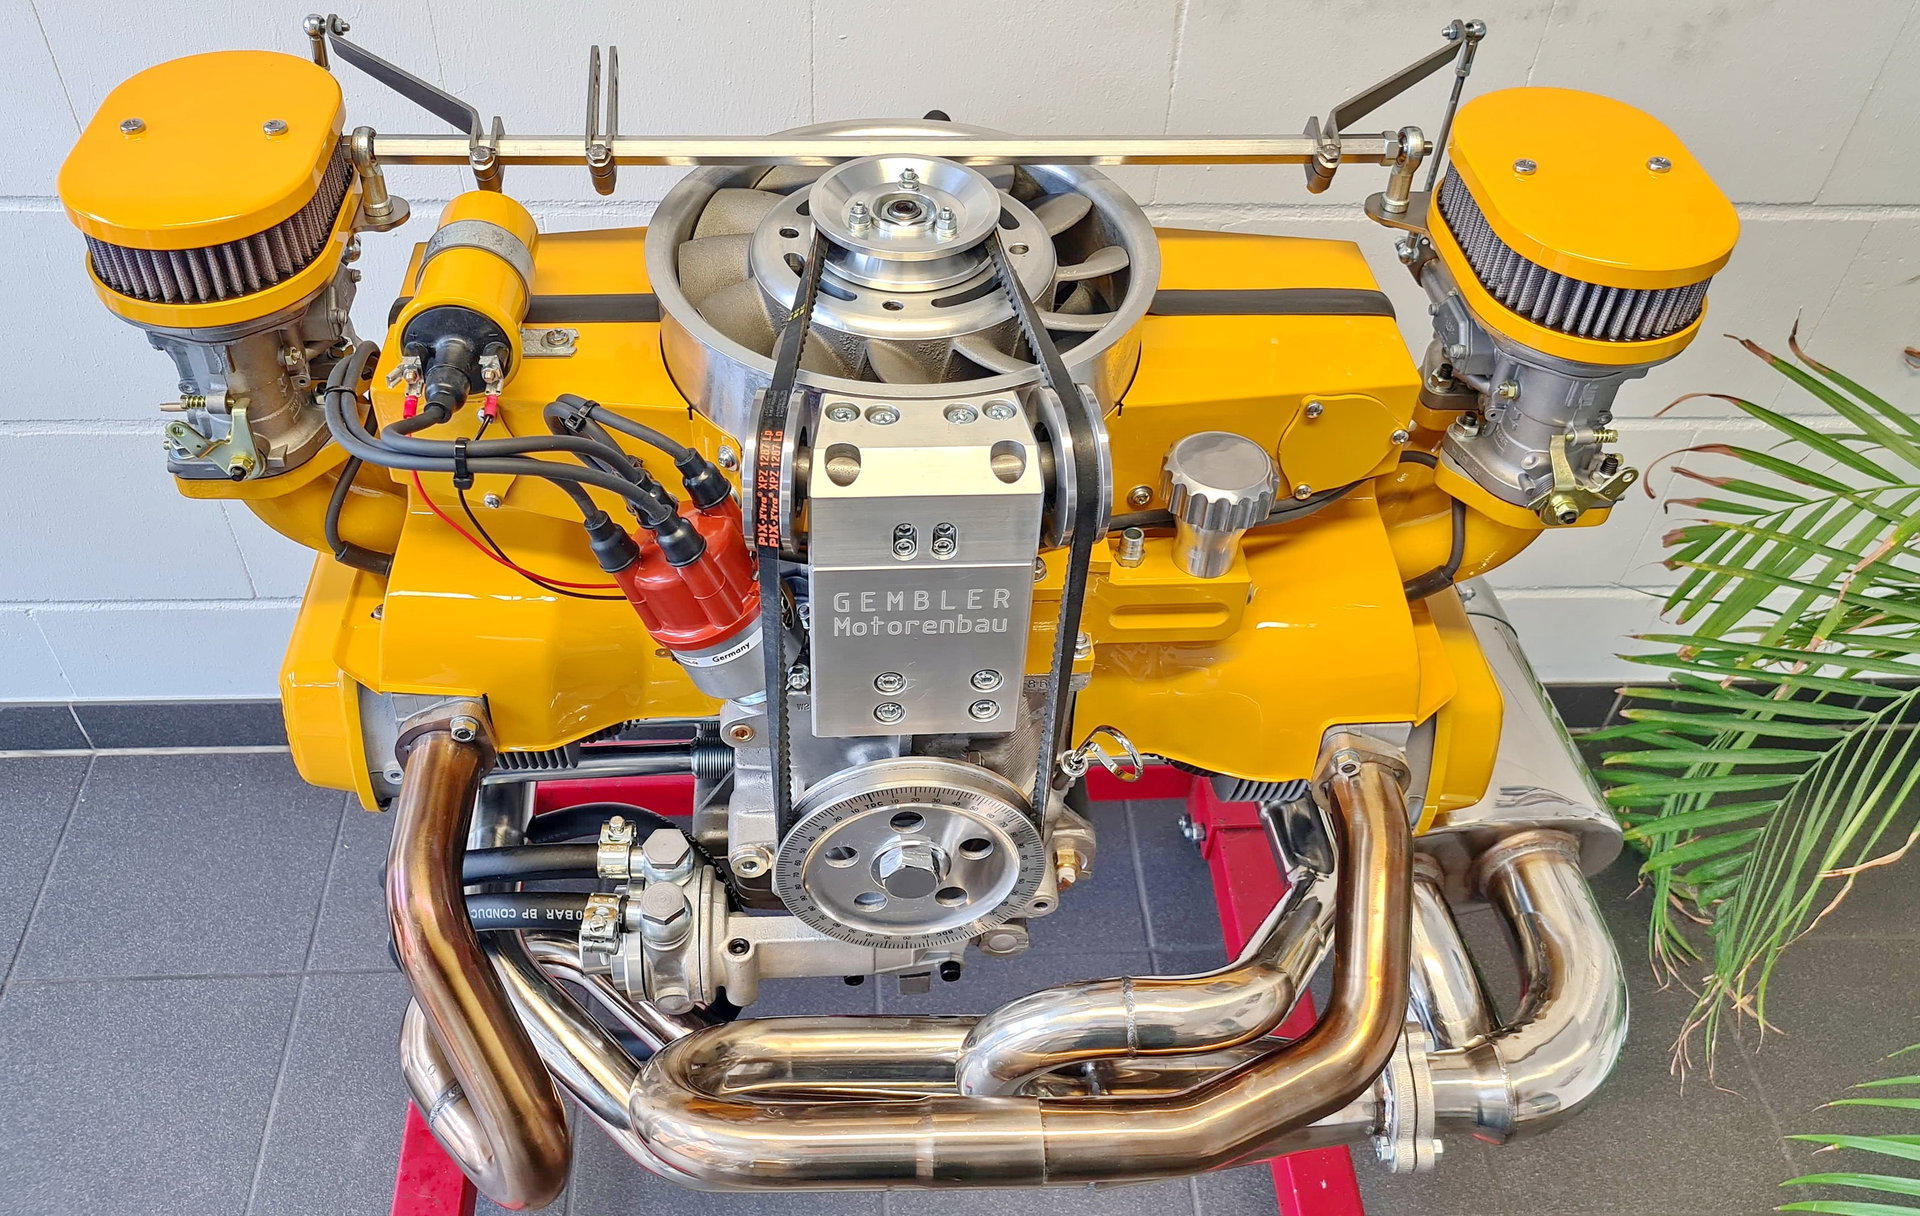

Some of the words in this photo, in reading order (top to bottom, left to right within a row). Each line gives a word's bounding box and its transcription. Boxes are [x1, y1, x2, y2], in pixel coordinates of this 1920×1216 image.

[760, 443, 770, 467] 1287
[770, 444, 781, 468] 1287
[757, 469, 769, 490] XPZ
[768, 470, 780, 491] XPZ
[833, 588, 1011, 613] GEMBLER
[833, 614, 1008, 637] Motorenbau
[712, 641, 750, 663] Germany
[865, 801, 884, 810] TDC
[521, 908, 538, 919] BP
